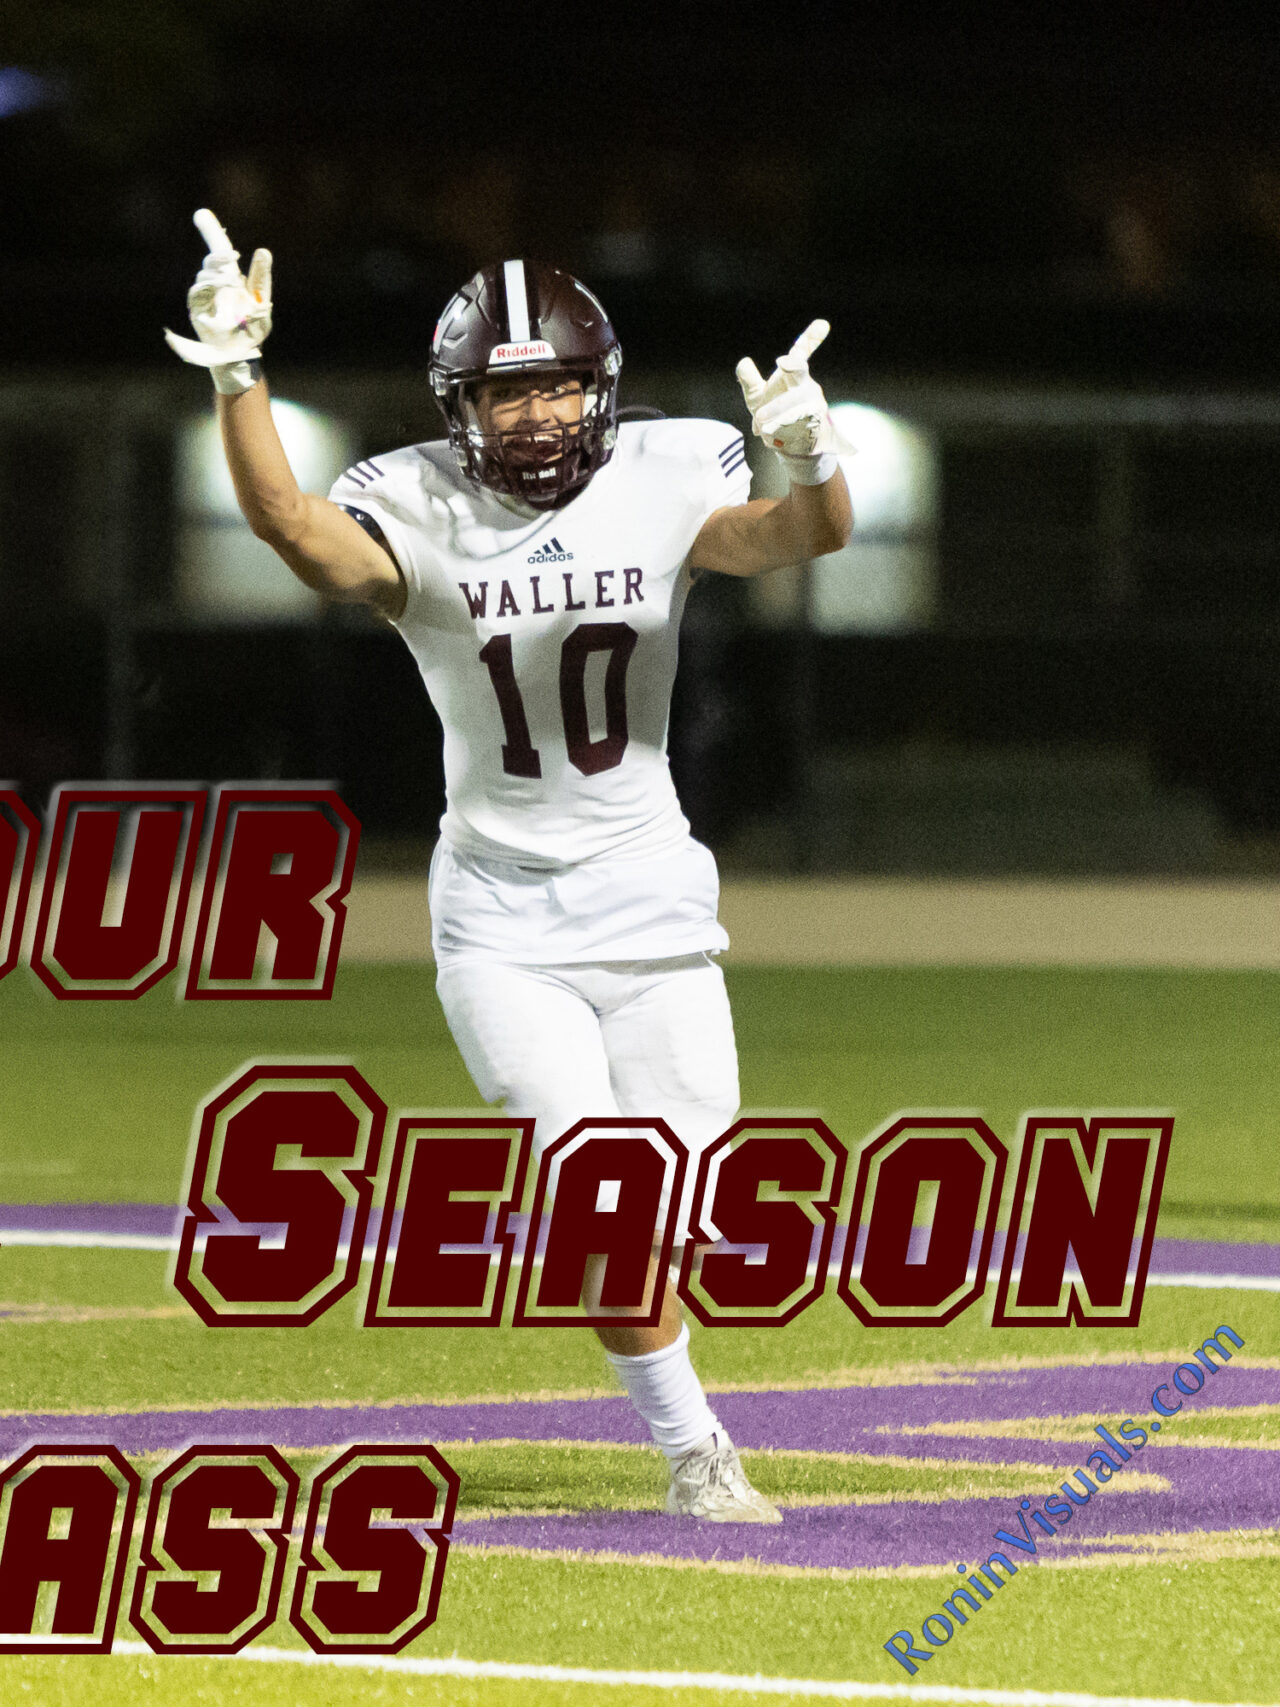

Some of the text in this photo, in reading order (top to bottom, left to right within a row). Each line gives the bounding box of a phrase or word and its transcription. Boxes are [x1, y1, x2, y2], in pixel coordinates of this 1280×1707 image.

[496, 343, 546, 359] Riddell
[527, 551, 574, 565] adidas
[458, 567, 644, 620] WALLER
[479, 621, 638, 779] 10
